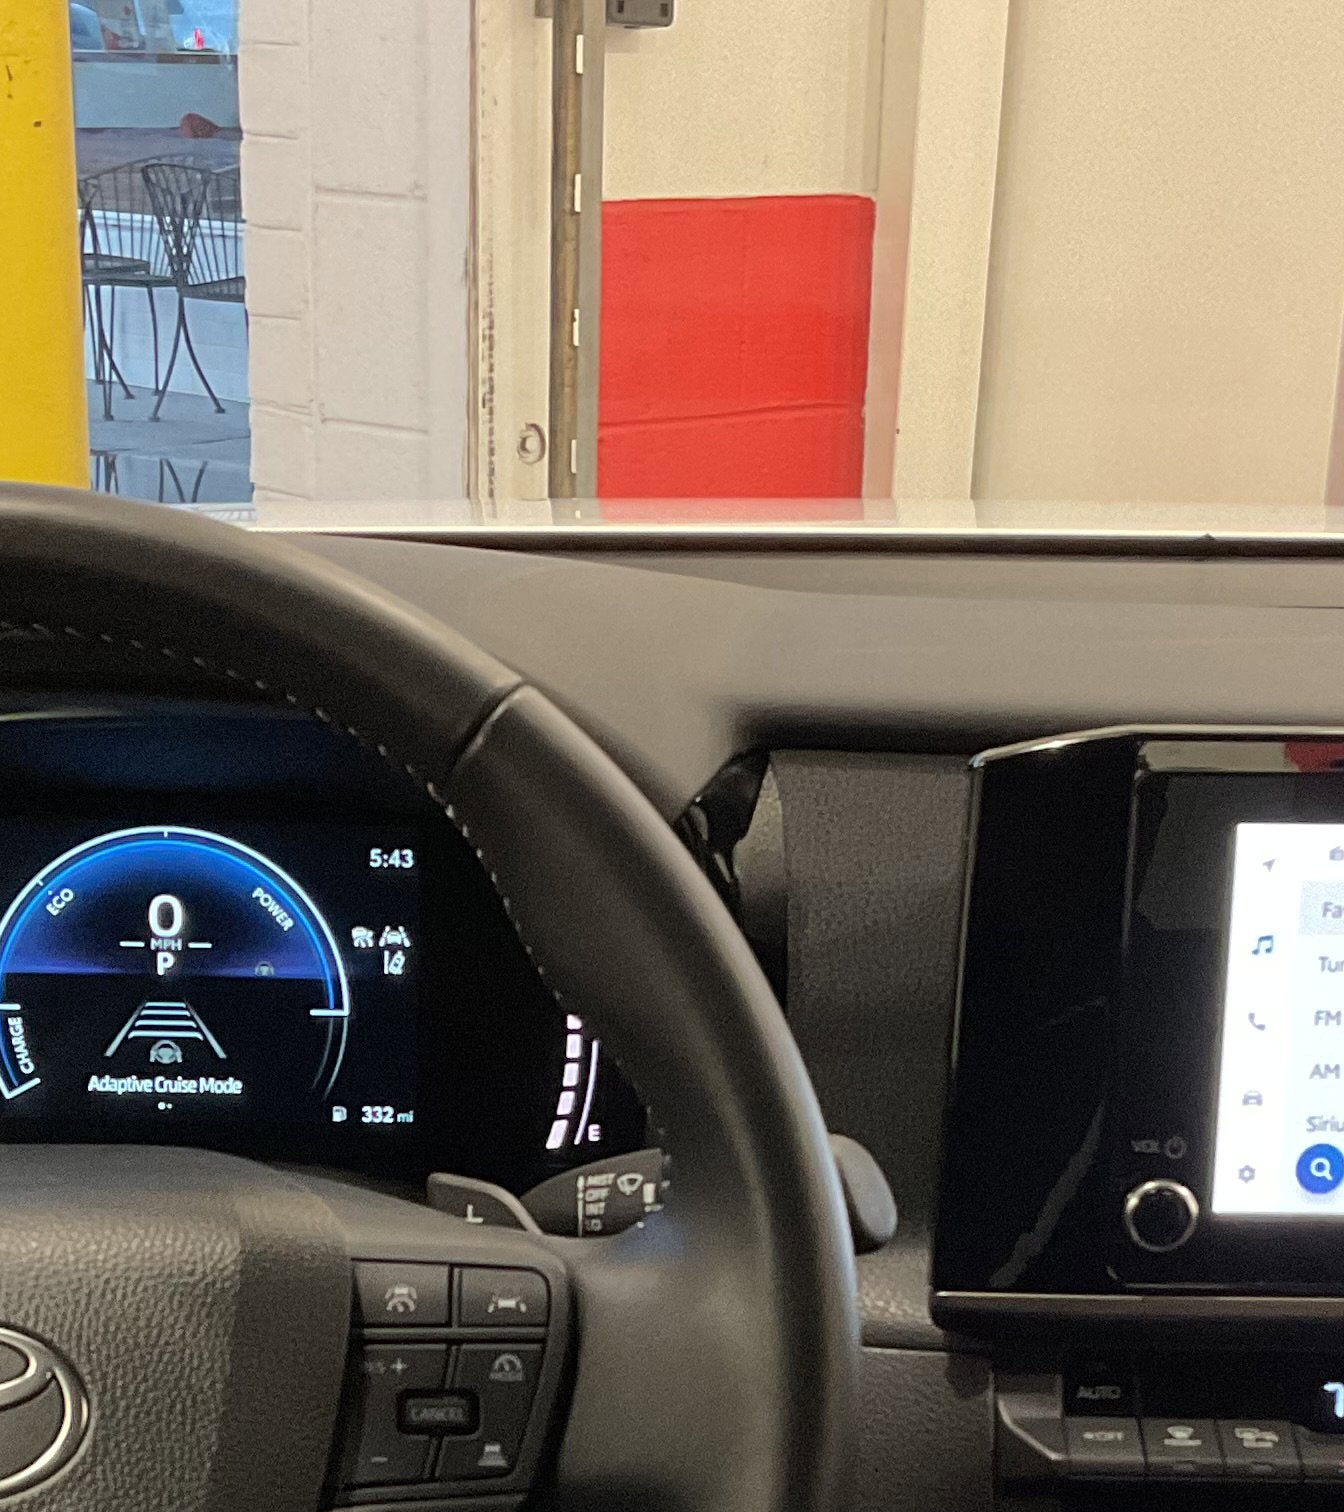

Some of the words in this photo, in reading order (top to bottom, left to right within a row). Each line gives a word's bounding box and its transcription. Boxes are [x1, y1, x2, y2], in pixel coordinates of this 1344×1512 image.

[369, 848, 414, 868] 5:43
[45, 888, 75, 916] ECO
[252, 887, 294, 931] POWER
[148, 893, 183, 937] 0
[150, 938, 182, 951] MPH
[156, 951, 175, 976] P
[1314, 1011, 1342, 1028] FM
[7, 1016, 35, 1075] CHARGE
[1309, 1064, 1341, 1081] AM
[88, 1074, 153, 1096] Adaptive
[154, 1075, 198, 1094] Cruise
[199, 1076, 243, 1095] Mode
[361, 1105, 395, 1123] 332
[397, 1110, 414, 1123] mi
[587, 1123, 601, 1142] E
[585, 1188, 610, 1202] OFF
[467, 1204, 483, 1224] L
[585, 1201, 606, 1217] INT
[1076, 1385, 1121, 1400] AUTO
[410, 1407, 464, 1421] CANCEL
